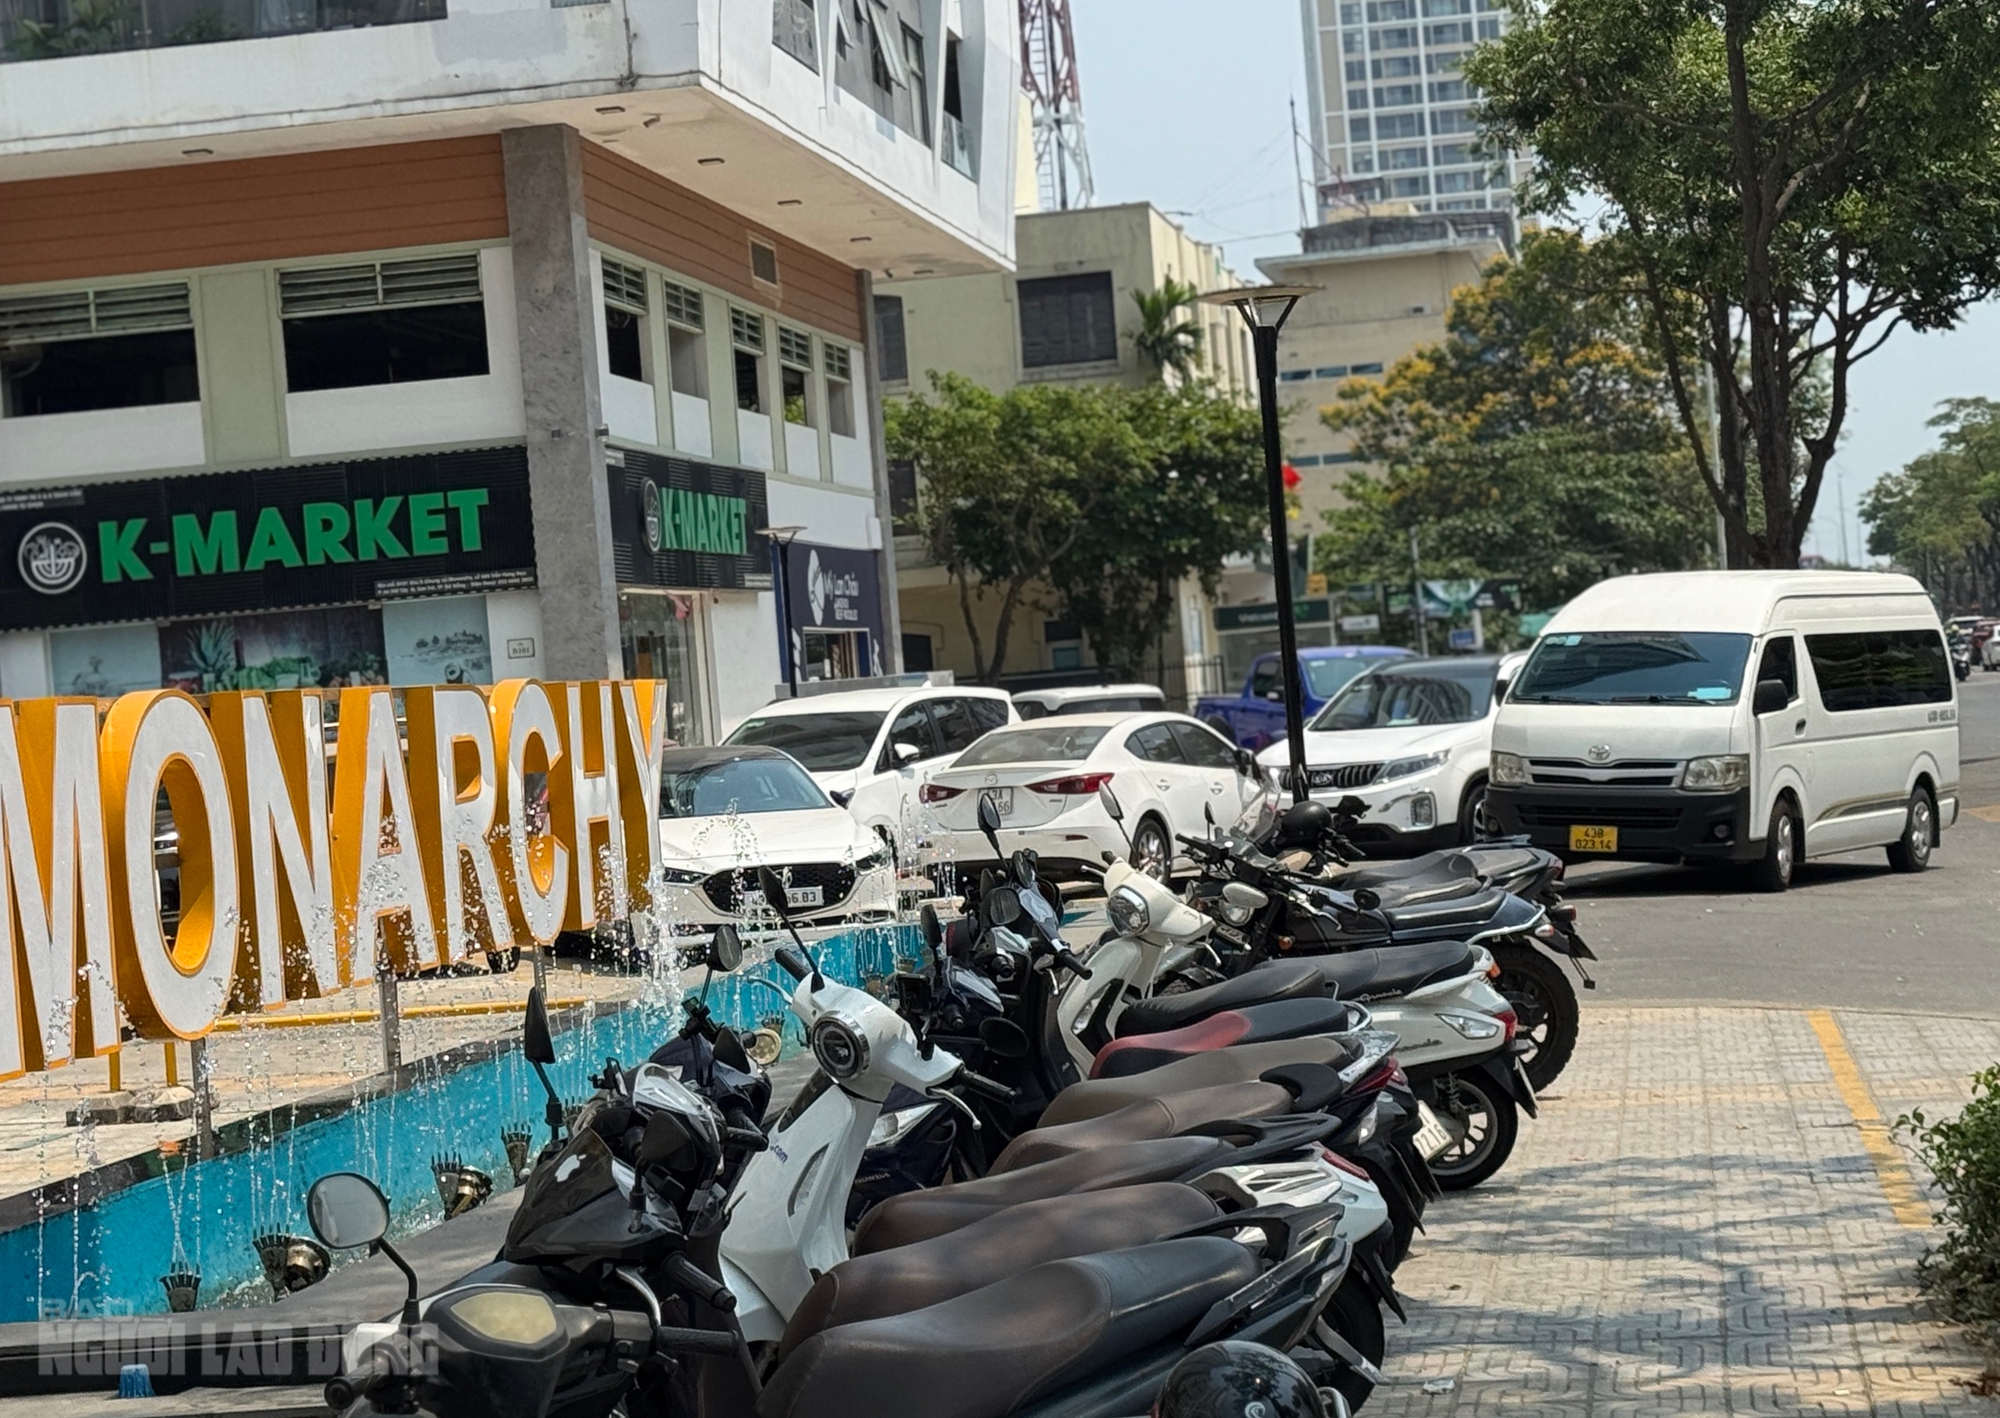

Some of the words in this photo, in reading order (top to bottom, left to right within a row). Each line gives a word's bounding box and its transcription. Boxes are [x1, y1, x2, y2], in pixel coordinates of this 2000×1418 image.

[98, 488, 490, 583] K-MARKET
[661, 487, 748, 555] K-MARKET
[1575, 838, 1613, 850] 023.14
[1584, 827, 1605, 838] 43B
[0, 678, 667, 1082] MONARCHY
